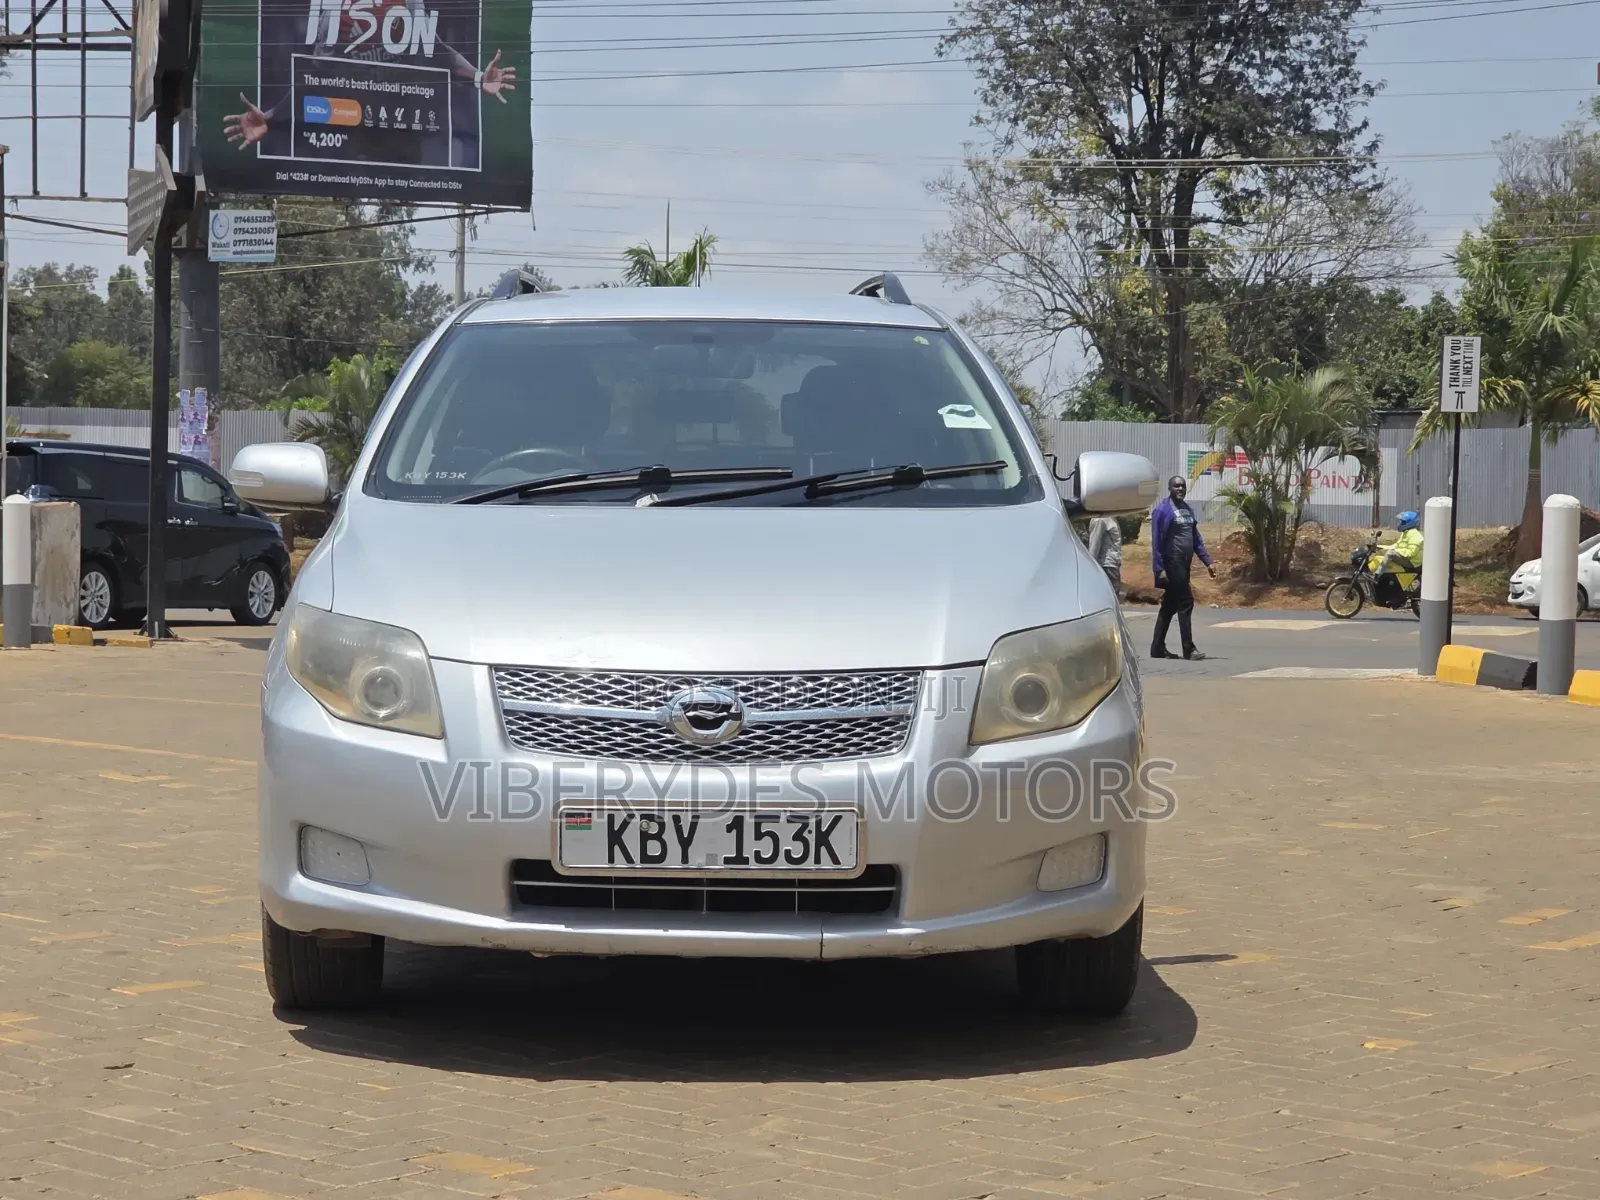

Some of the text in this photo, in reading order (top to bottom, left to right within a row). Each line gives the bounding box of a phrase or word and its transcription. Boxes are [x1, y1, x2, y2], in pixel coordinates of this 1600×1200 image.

[382, 5, 438, 57] ON
[304, 74, 434, 98] The world's best football package
[309, 132, 342, 148] 4,200
[276, 172, 288, 180] Dial
[318, 174, 349, 184] Download
[350, 176, 373, 186] MyDStv
[374, 178, 386, 187] App
[395, 179, 408, 188] stay
[409, 180, 440, 188] Connected
[1449, 339, 1461, 388] THANK YOU
[1462, 339, 1474, 387] TILL NEXT TIME
[608, 814, 700, 865] KBY
[722, 814, 842, 865] 153K
